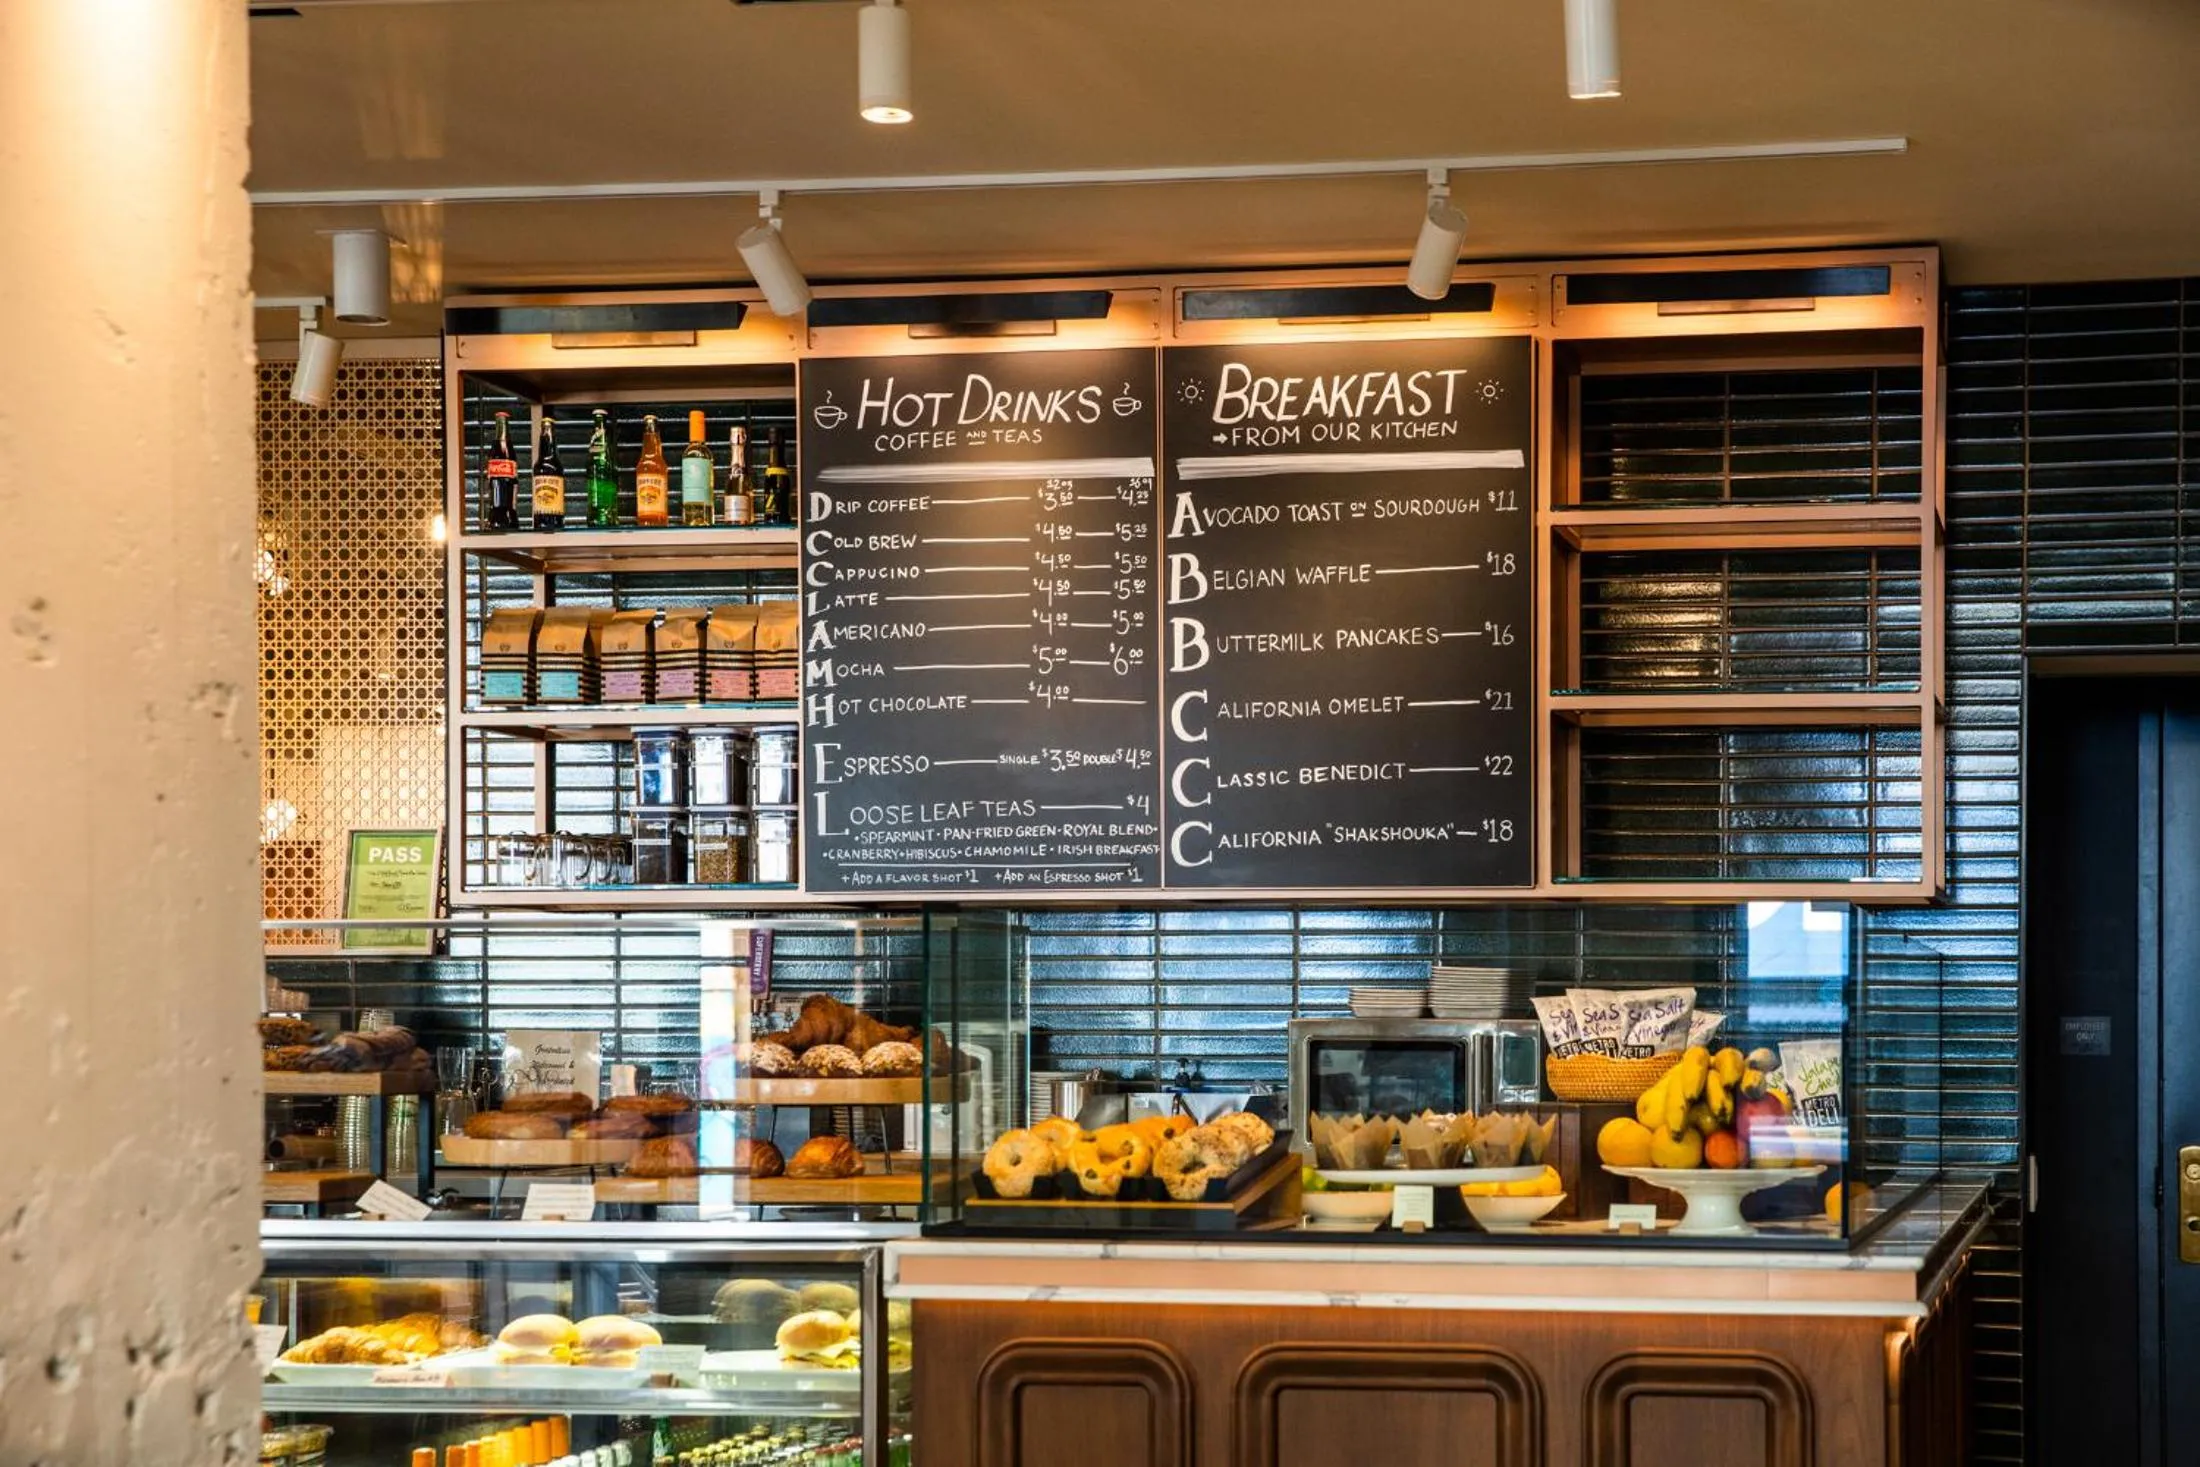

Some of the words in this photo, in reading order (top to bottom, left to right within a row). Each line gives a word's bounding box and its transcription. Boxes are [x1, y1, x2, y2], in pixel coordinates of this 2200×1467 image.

[857, 377, 954, 429] HOT
[957, 373, 1102, 424] DRINKS
[1213, 363, 1467, 424] BREAKFAST
[875, 431, 956, 451] COFFEE
[966, 431, 987, 446] AND
[992, 429, 1042, 445] TEAS
[1232, 425, 1300, 447] FROM
[1311, 421, 1362, 442] OUR
[1371, 420, 1458, 440] KITCHEN
[806, 491, 861, 522] DRIP
[868, 496, 931, 513] COFFEE
[1167, 491, 1280, 538] AVOCADO
[1287, 502, 1344, 522] TOAST
[1350, 500, 1366, 517] ON
[1374, 498, 1480, 519] SOURDOUGH
[1488, 490, 1519, 512] $11
[806, 530, 863, 556] COLD
[869, 534, 917, 551] BREW
[806, 561, 920, 587] CAPPUCINO
[1167, 552, 1285, 604] BELGIAN
[1296, 564, 1372, 585] WAFFLE
[1486, 551, 1516, 576] $18
[805, 590, 879, 617] LATTE
[806, 619, 926, 653] AMERICANO
[1169, 617, 1325, 673] BUTTERMILK
[1336, 627, 1440, 649] PANCAKES
[1485, 621, 1514, 646] $16
[806, 658, 885, 688] MOCHA
[806, 693, 862, 729] HOT
[869, 695, 968, 713] CHOCOLATE
[1170, 689, 1321, 743] CALIFORNIA
[1328, 696, 1404, 717] OMELET
[1485, 688, 1514, 711] $21
[813, 743, 929, 784] ESPRESSO
[1000, 754, 1040, 764] SINGLE
[1042, 748, 1081, 771] $3.50
[1083, 754, 1117, 765] DOUBLE
[1117, 748, 1152, 769] $4.50
[1171, 757, 1290, 807] CLASSIC
[1299, 763, 1406, 785] BENEDICT
[1485, 755, 1513, 776] $22
[813, 791, 913, 836] LOOSE
[920, 801, 975, 823] LEAF
[979, 799, 1036, 817] TEAS
[1126, 795, 1149, 816] $4
[1015, 825, 1056, 839] GREEN
[1063, 824, 1104, 838] ROYAL
[1170, 820, 1322, 867] CALIFORNIA
[1326, 822, 1454, 844] "SHAKSHOUKA"
[1483, 819, 1513, 843] $18
[368, 847, 422, 863] PASS
[1058, 845, 1092, 855] IRISH
[877, 874, 882, 883] A
[885, 873, 929, 884] FLAVOR
[933, 873, 963, 883] SHOT
[1044, 869, 1091, 884] ESPRESSO
[1095, 872, 1123, 883] SHOT
[1655, 997, 1684, 1020] Salt
